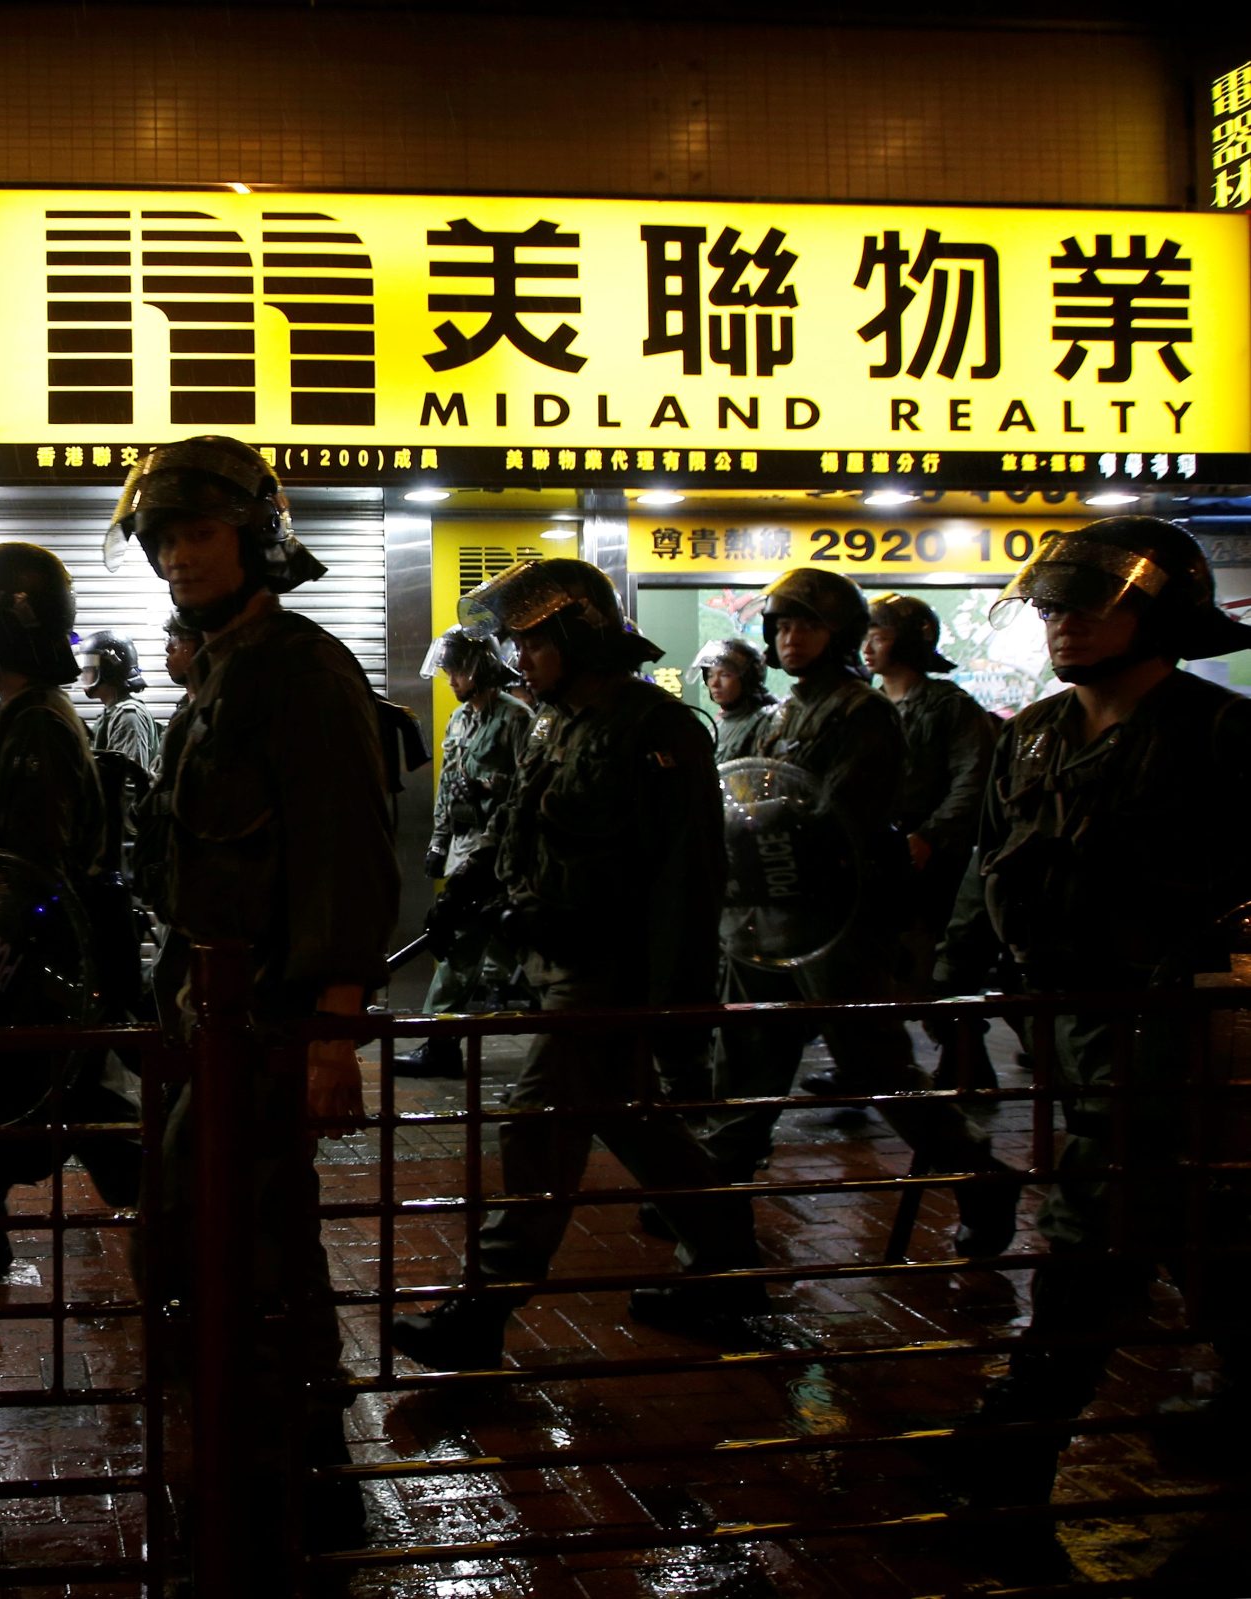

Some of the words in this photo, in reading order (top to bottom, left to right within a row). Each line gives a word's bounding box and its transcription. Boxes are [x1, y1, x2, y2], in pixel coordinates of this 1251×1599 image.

[422, 218, 1194, 383] 美聯物業
[419, 392, 821, 431] MIDLAND
[891, 399, 1194, 434] REALTY
[506, 449, 758, 472] 美聯物業代理有限公司
[651, 527, 792, 562] 尊貴熱線
[809, 529, 948, 563] 2920
[756, 831, 800, 898] POLICE
